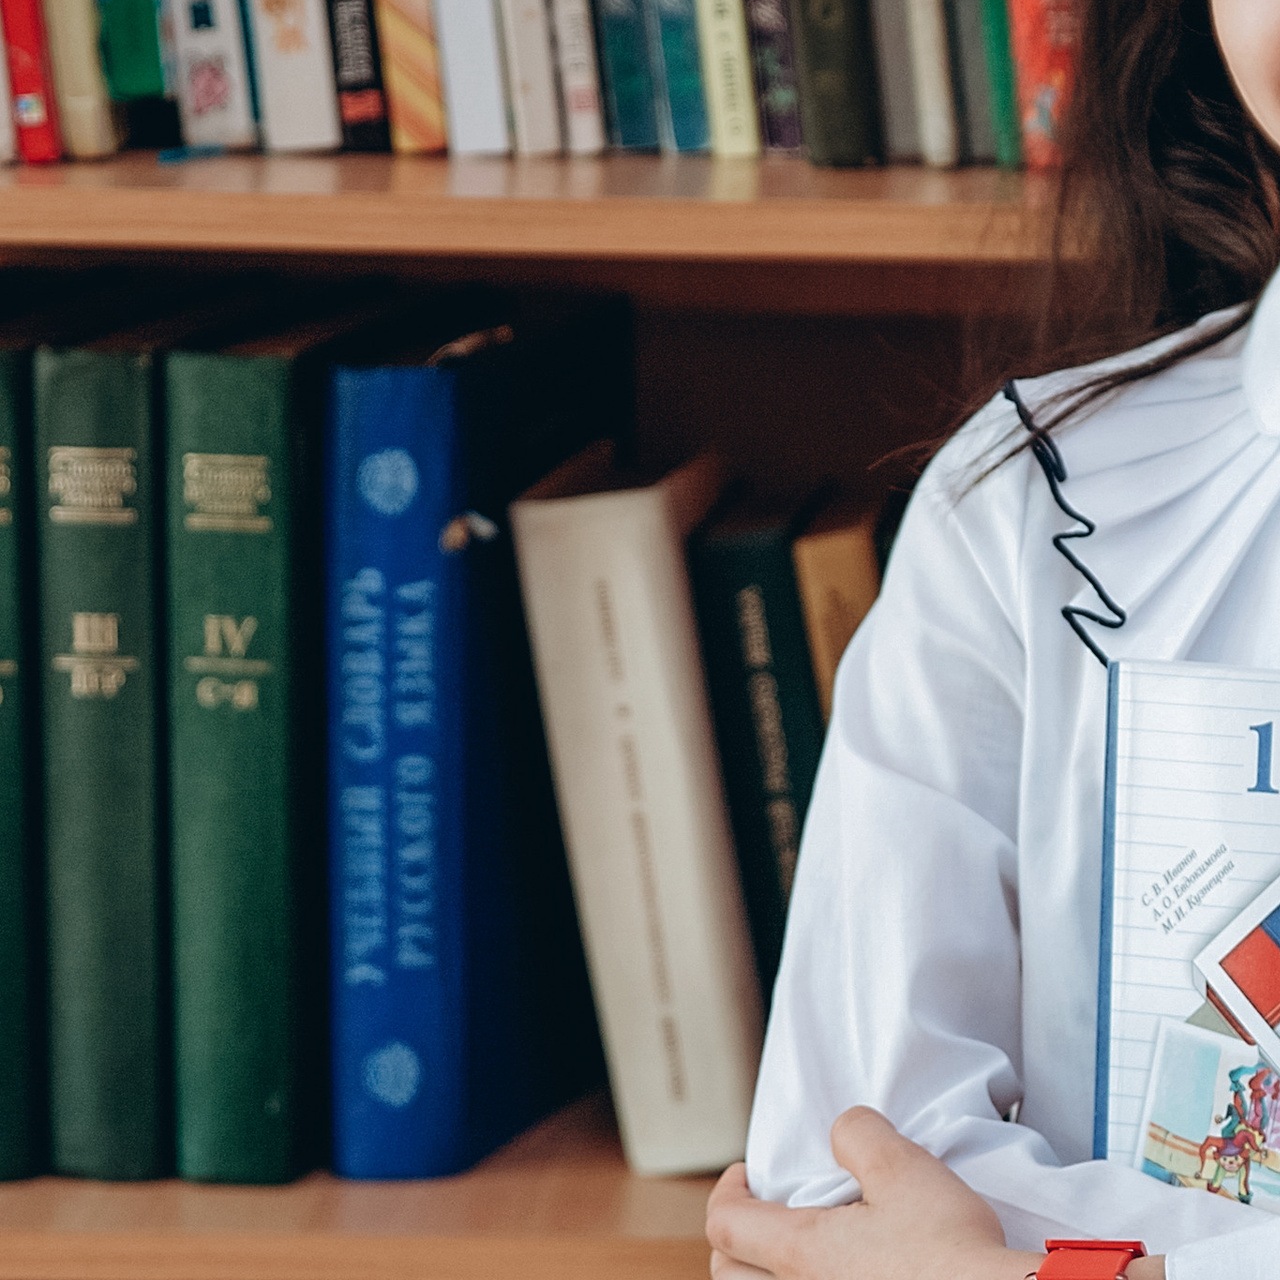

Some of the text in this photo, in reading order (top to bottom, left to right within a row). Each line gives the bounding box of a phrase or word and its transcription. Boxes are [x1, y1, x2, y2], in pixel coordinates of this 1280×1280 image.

[204, 614, 259, 658] IV
[1247, 721, 1280, 794] 1
[1162, 849, 1197, 885] Иванов
[1174, 842, 1228, 898] Евдокимова
[1161, 919, 1176, 934] М.
[1186, 860, 1235, 910] Кузнецова
